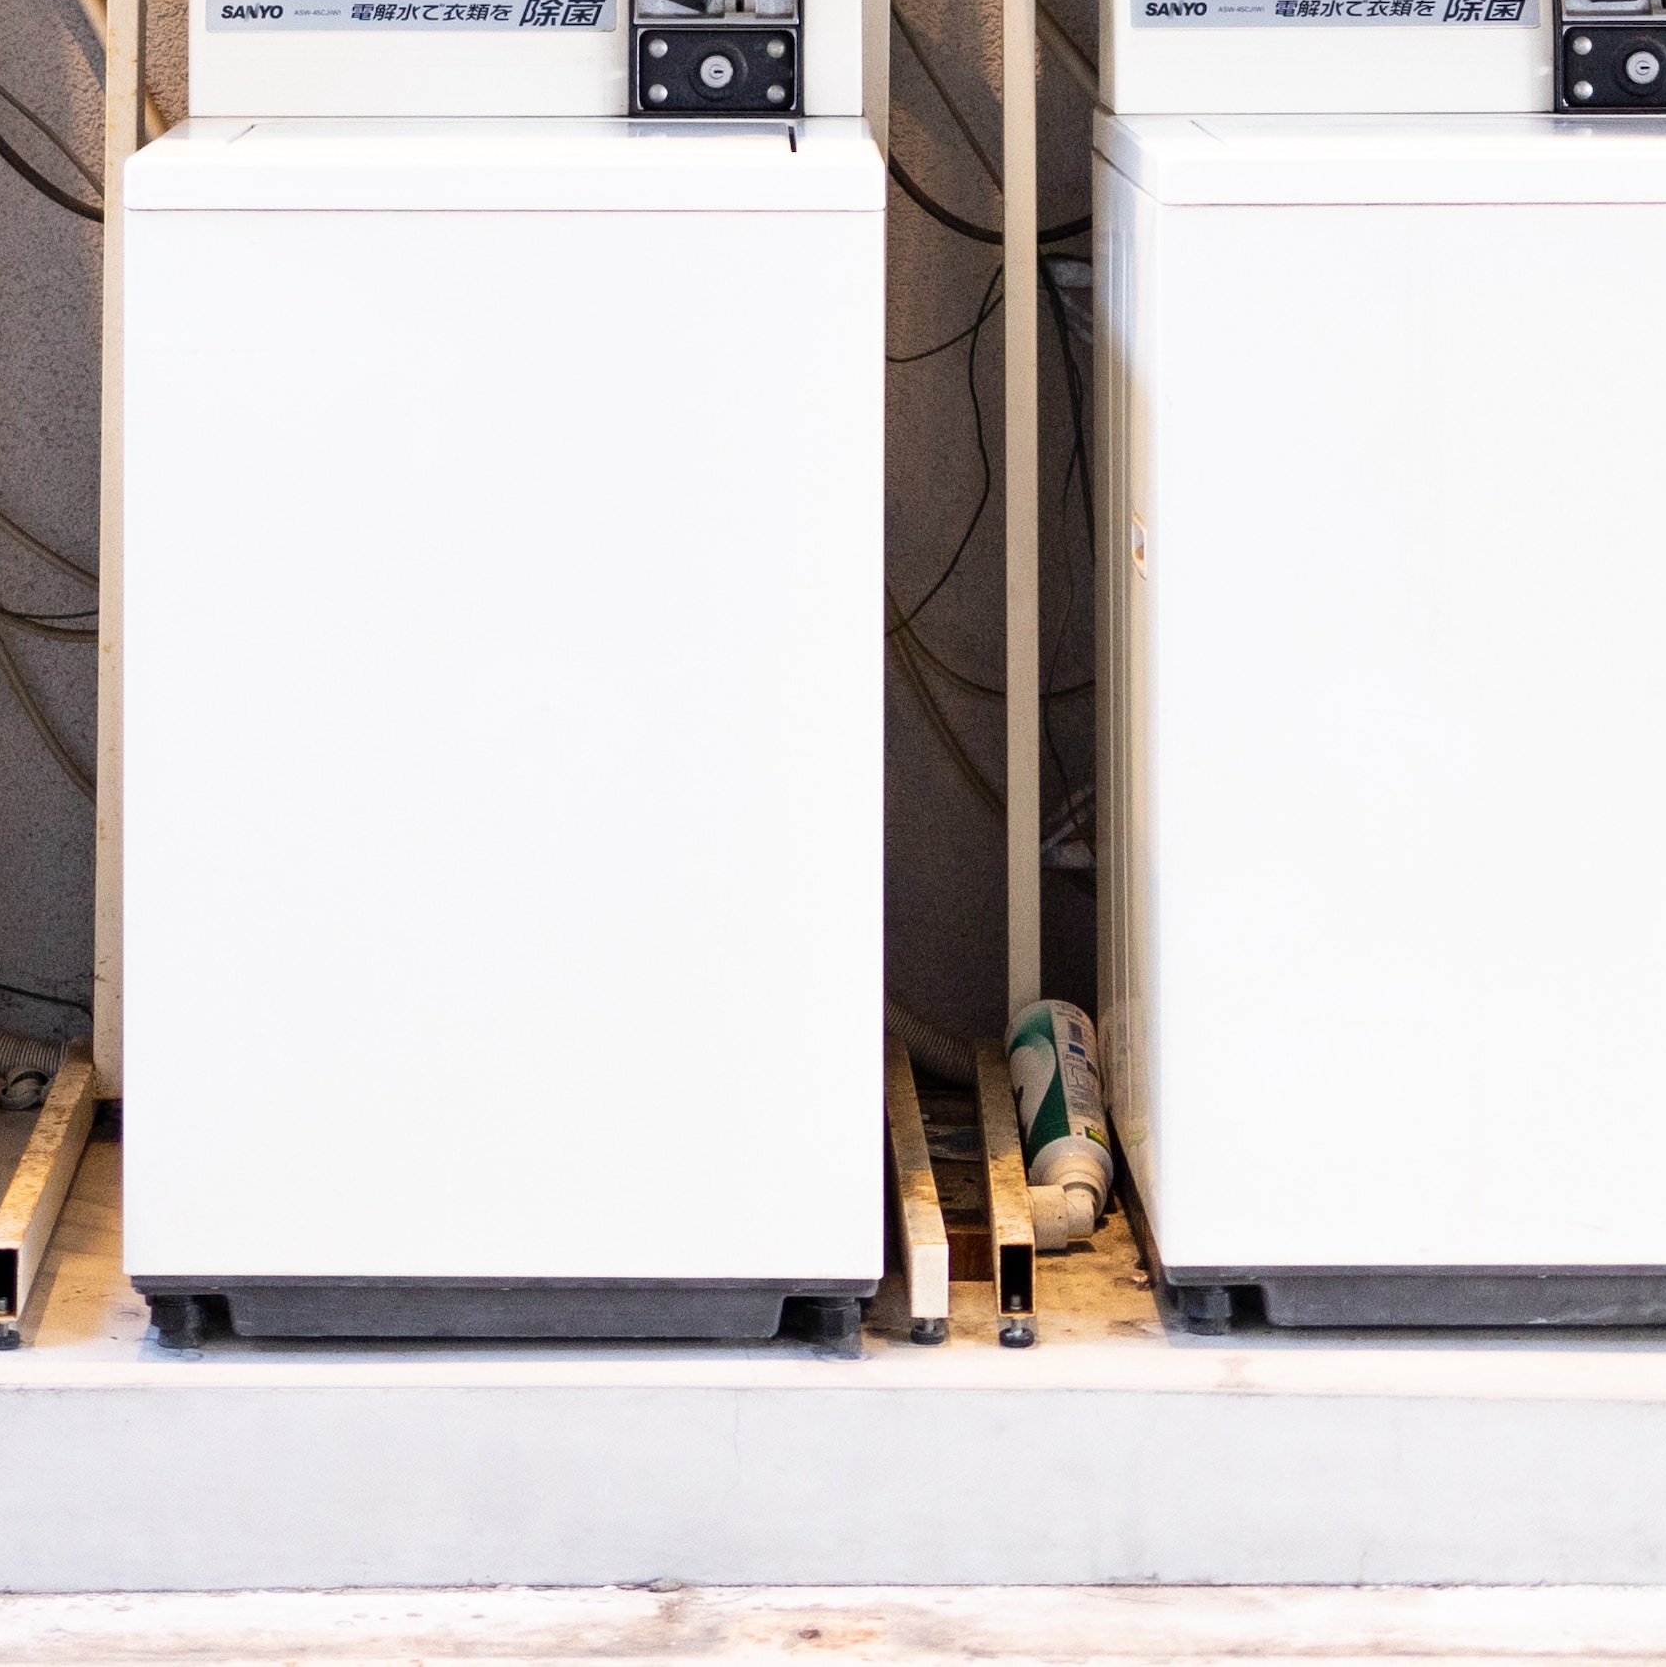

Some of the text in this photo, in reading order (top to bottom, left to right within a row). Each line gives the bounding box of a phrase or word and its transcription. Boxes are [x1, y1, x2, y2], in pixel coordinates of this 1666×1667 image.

[221, 3, 283, 20] SANYO
[350, 3, 513, 21] 電解水で衣類を
[1144, 0, 1207, 17] SANYO
[1274, 0, 1437, 17] 電解水で衣類を
